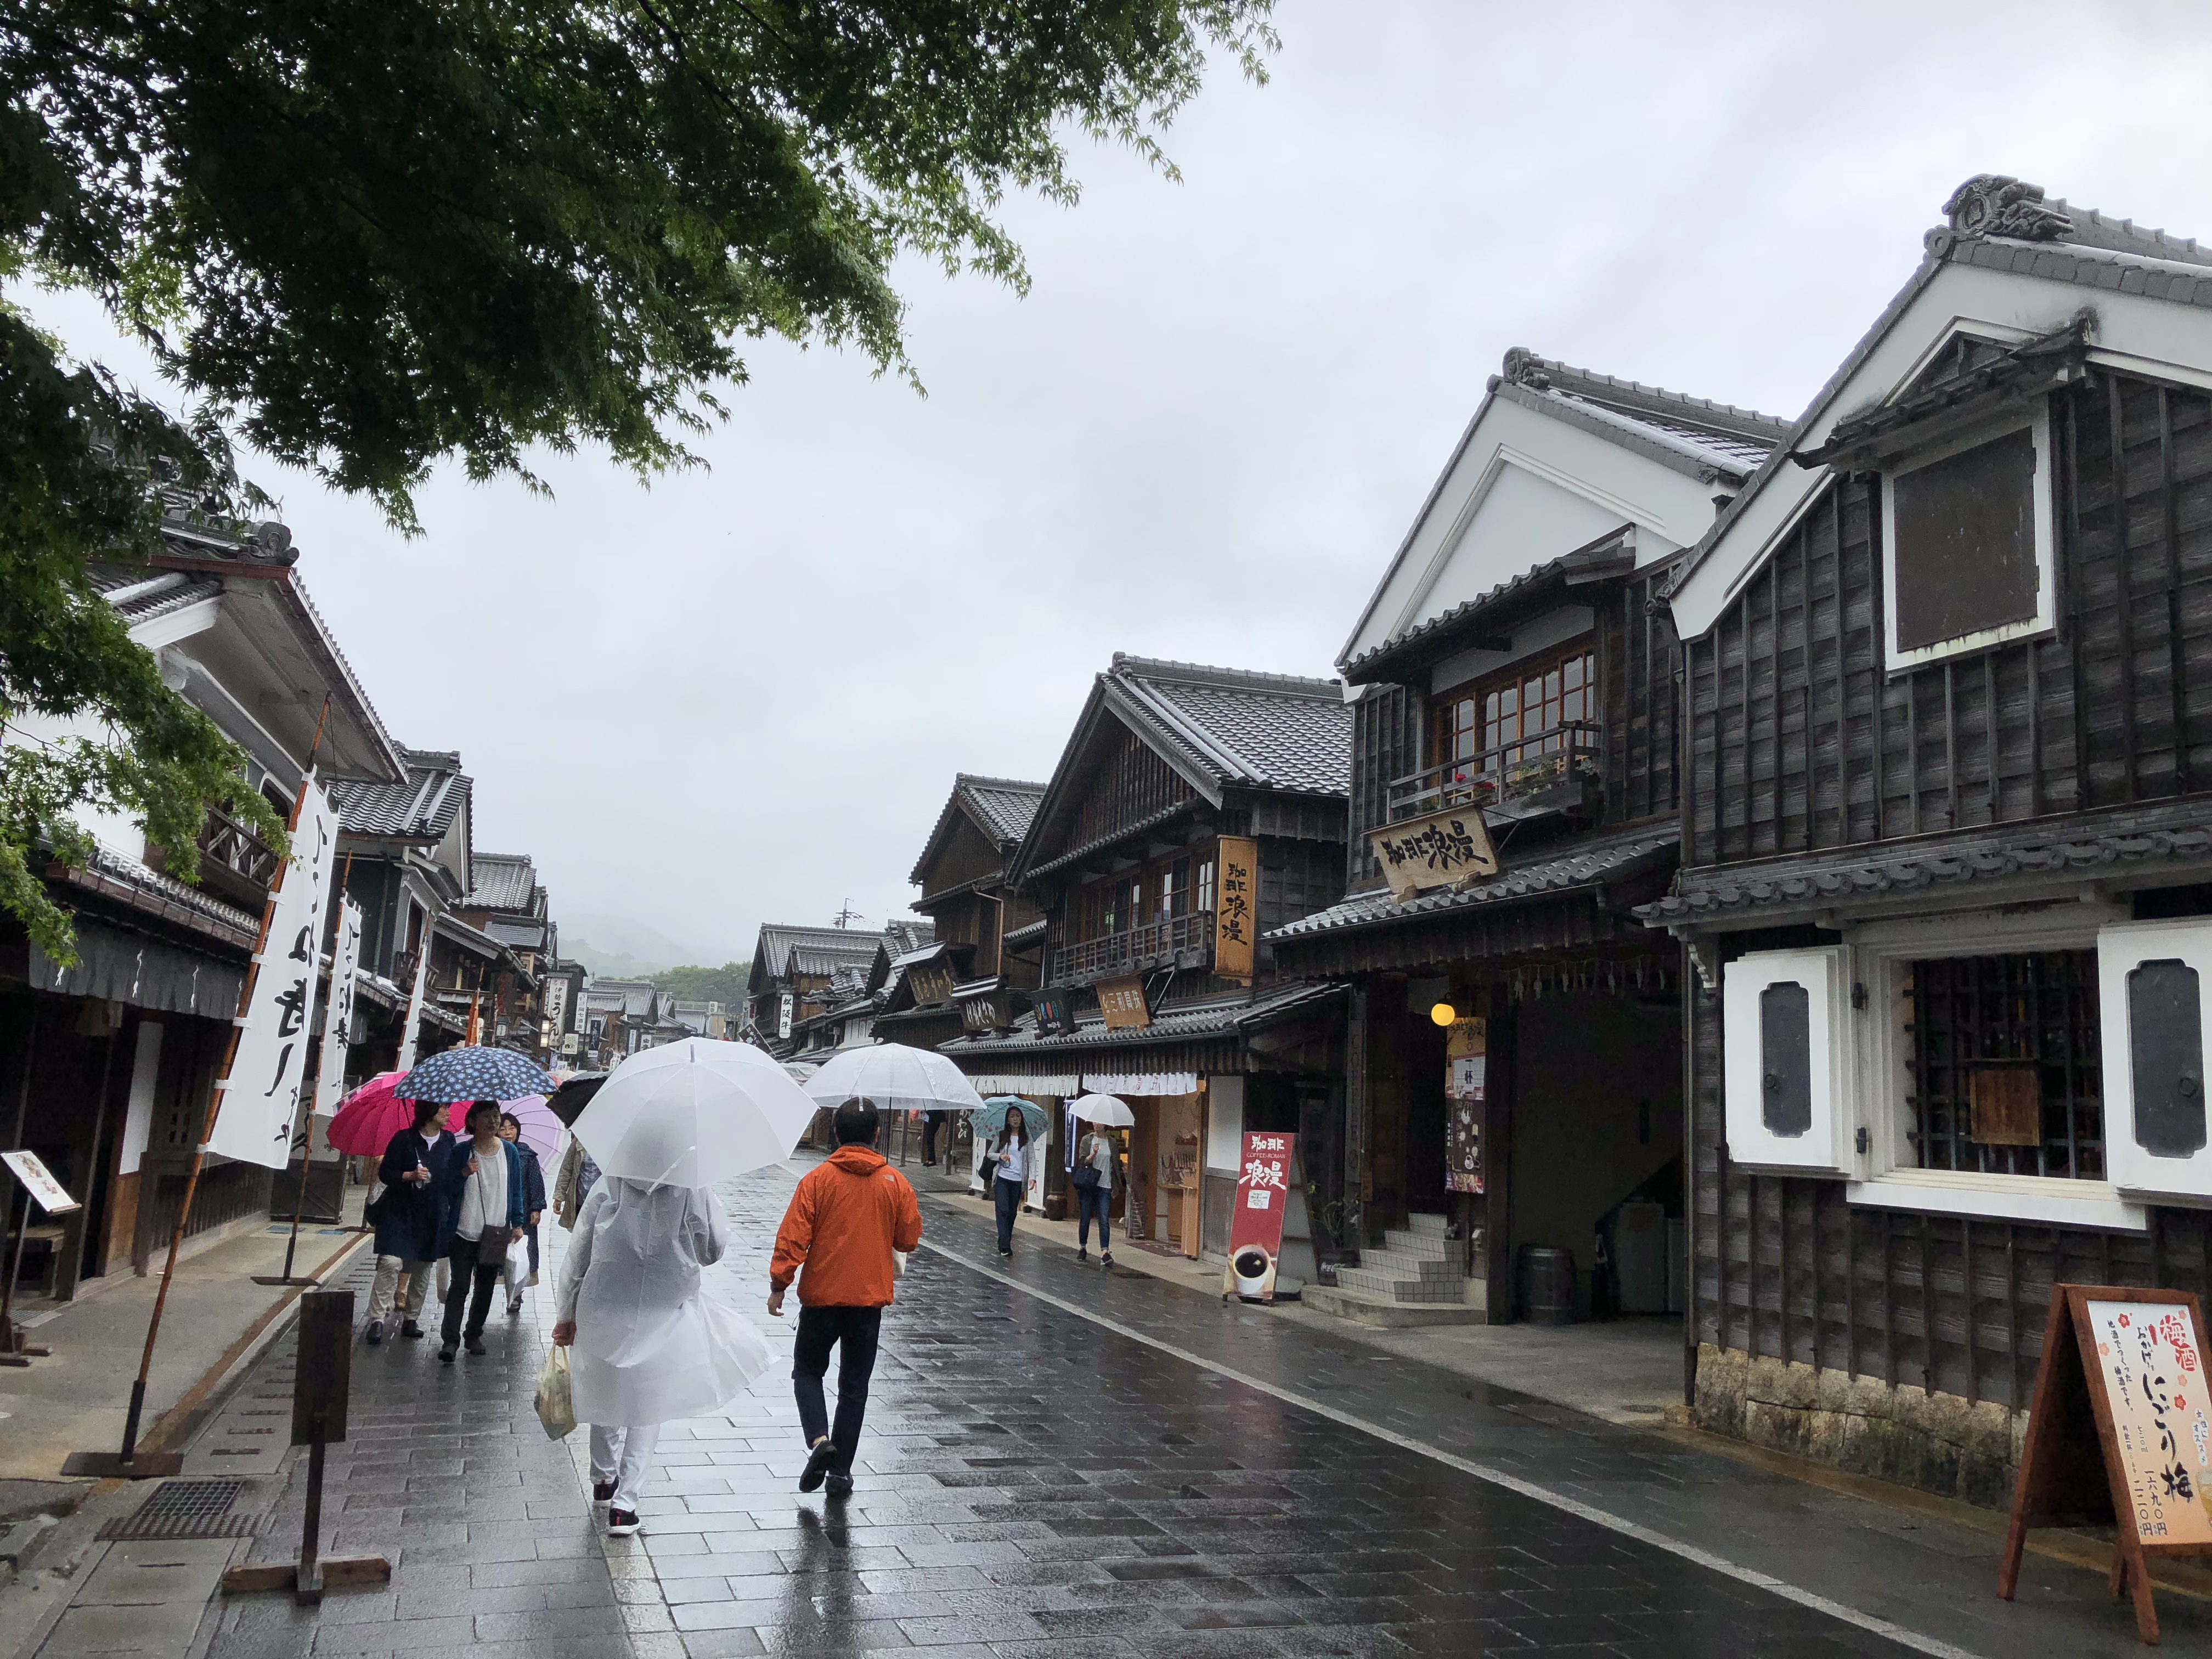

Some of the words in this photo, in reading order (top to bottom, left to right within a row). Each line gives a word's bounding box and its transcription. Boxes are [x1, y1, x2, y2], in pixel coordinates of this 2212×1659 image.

[1380, 819, 1489, 870] 珈琲浪漫
[1220, 862, 1250, 946] 珈琲浪漫
[781, 997, 792, 1030] 松阪牛
[1251, 1135, 1285, 1152] 珈琲
[1239, 1159, 1286, 1190] 浪漫
[2159, 1314, 2198, 1372] 梅酒
